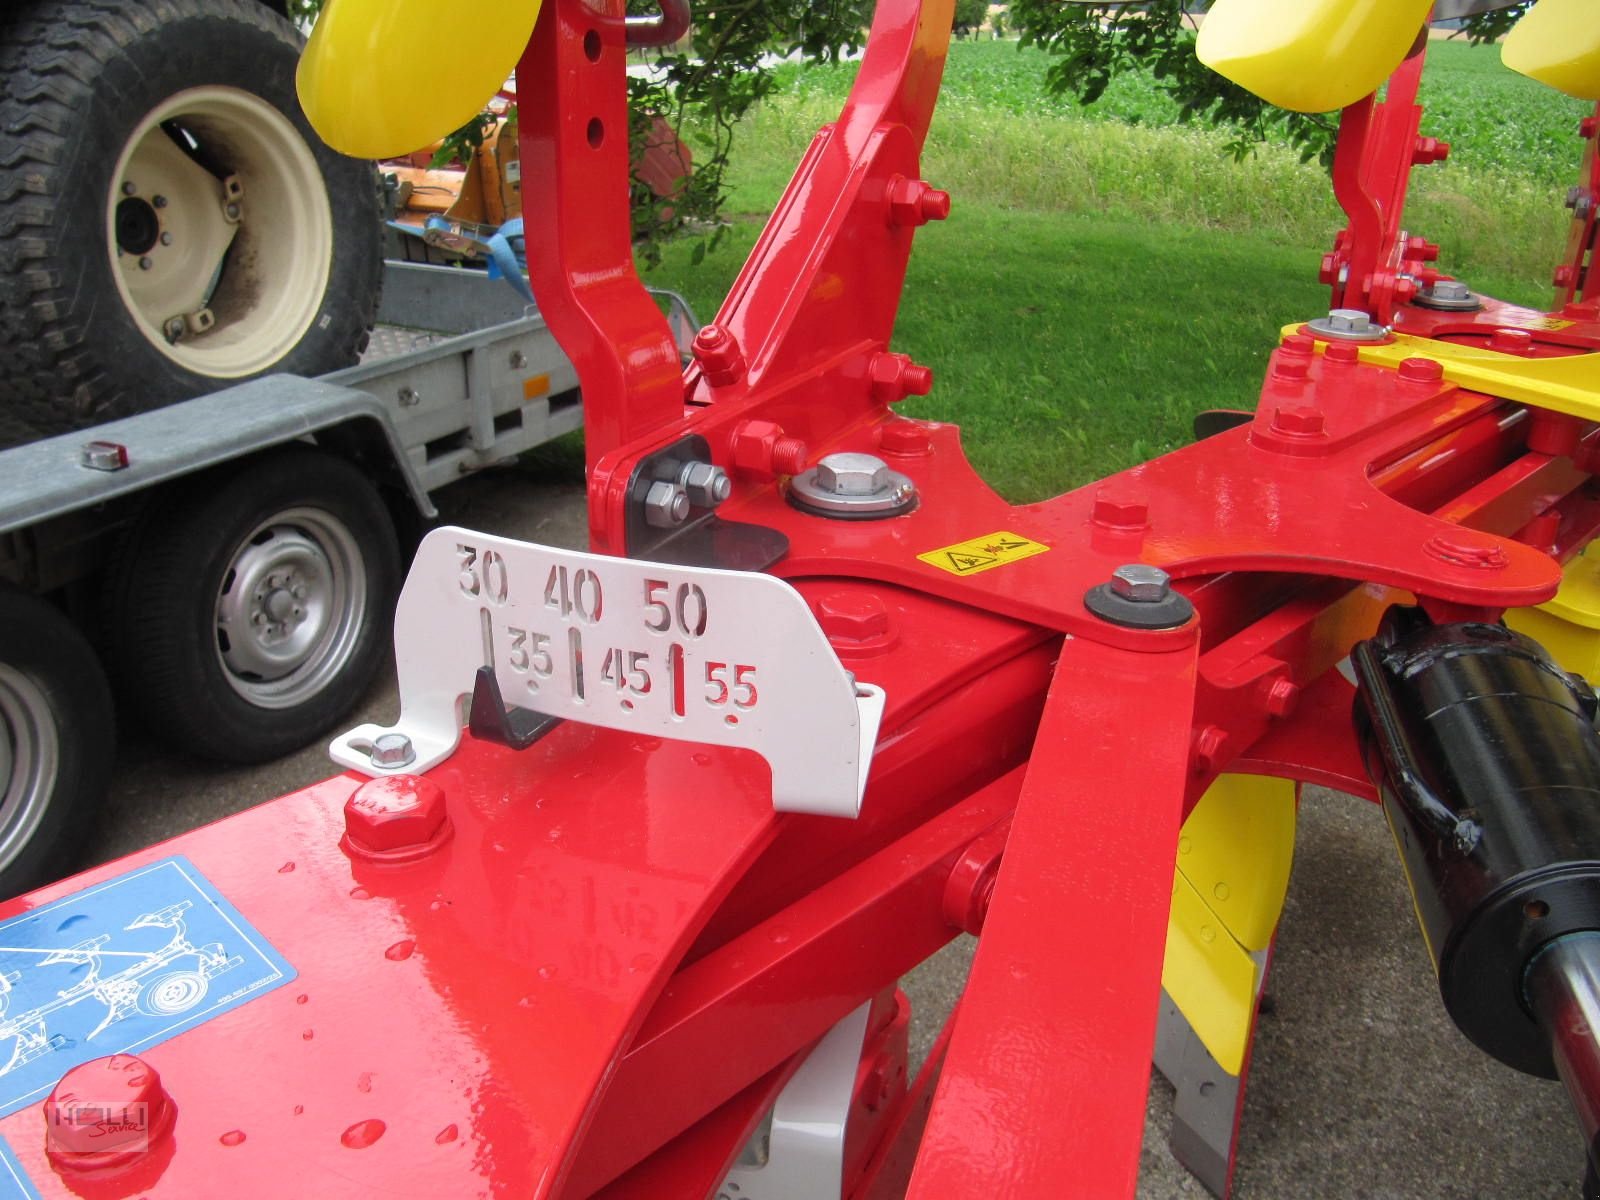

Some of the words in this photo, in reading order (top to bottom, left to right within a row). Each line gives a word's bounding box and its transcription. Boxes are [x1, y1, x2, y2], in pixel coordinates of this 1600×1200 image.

[457, 543, 508, 606] 30
[544, 564, 603, 624] 40
[643, 578, 708, 640] 50
[508, 626, 553, 678] 35
[601, 647, 651, 697] 45
[704, 661, 758, 712] 55
